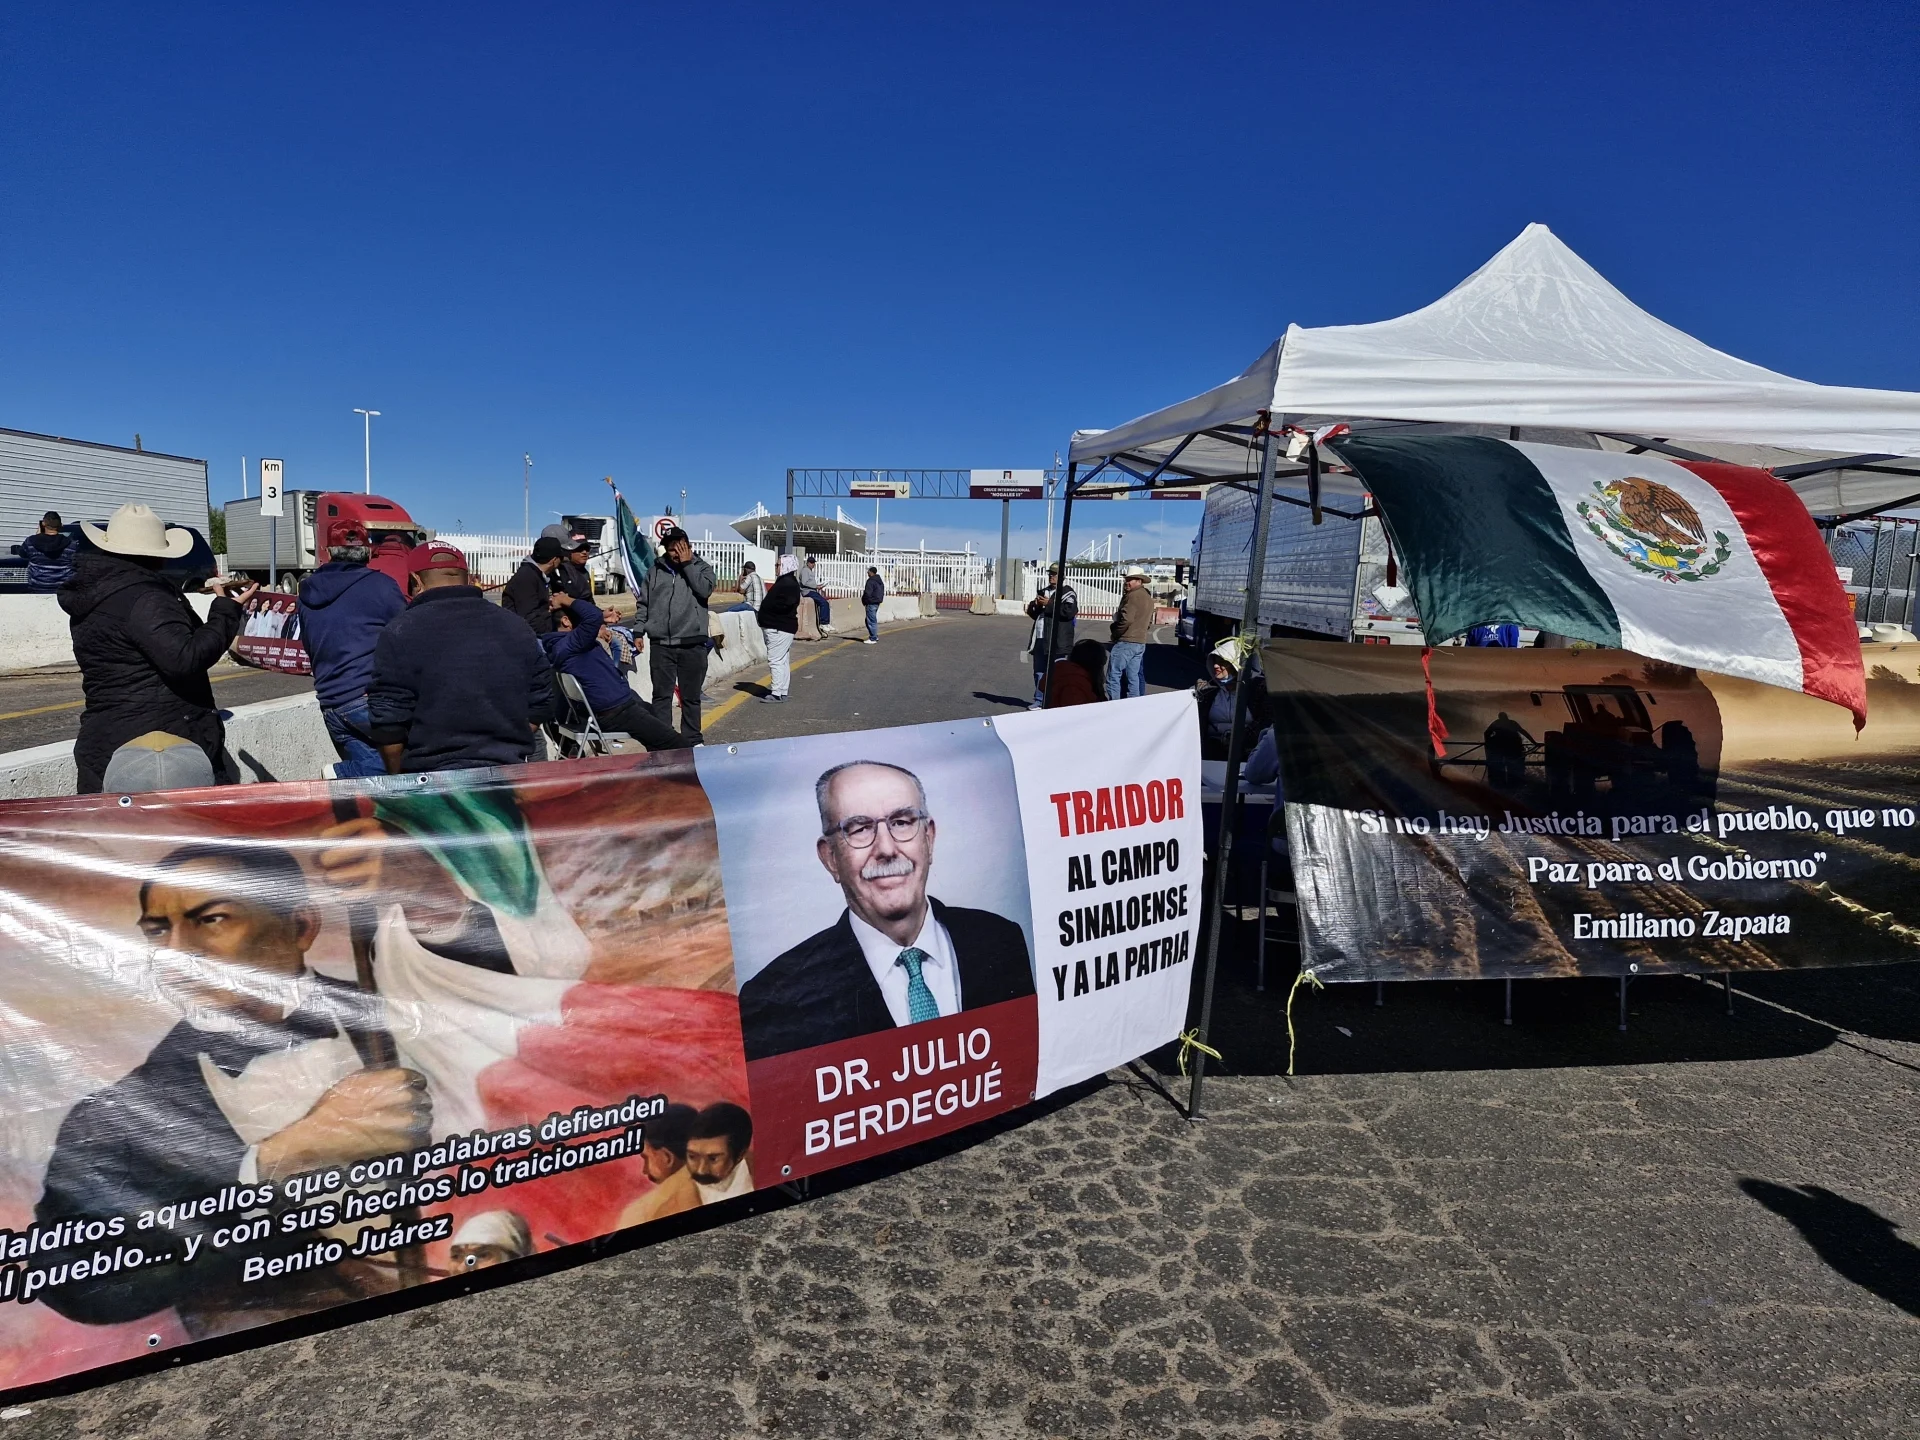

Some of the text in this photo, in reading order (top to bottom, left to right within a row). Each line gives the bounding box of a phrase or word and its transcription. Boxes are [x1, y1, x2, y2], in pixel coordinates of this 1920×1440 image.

[264, 461, 280, 471] km
[268, 486, 277, 499] 3
[1050, 778, 1184, 837] TRAIDOR
[1395, 815, 1430, 835] no
[1437, 810, 1490, 841] hay
[1499, 810, 1602, 836] Justicia
[1612, 814, 1679, 842] para
[1686, 808, 1710, 832] el
[1717, 805, 1820, 839] pueblo,
[1826, 808, 1875, 835] que
[1882, 807, 1915, 828] no
[1067, 838, 1179, 892] AL CAMPO
[1527, 851, 1827, 888] Paz para el Gobierno”
[1058, 884, 1188, 947] SINALOENSE
[1573, 910, 1791, 941] Emiliano Zapata
[1052, 930, 1189, 1001] Y A LA PATRIA
[815, 1027, 991, 1103] DR. JULIO
[805, 1061, 1002, 1156] BERDEGUÉ
[137, 1184, 274, 1230] aquellos
[284, 1170, 340, 1202] que
[350, 1156, 403, 1183] con
[412, 1128, 532, 1176] palabras
[541, 1098, 665, 1140] defienden
[0, 1129, 642, 1298] l pueblo... y con sus hechos lo traicionan!!
[242, 1218, 449, 1282] Benito Juárez
